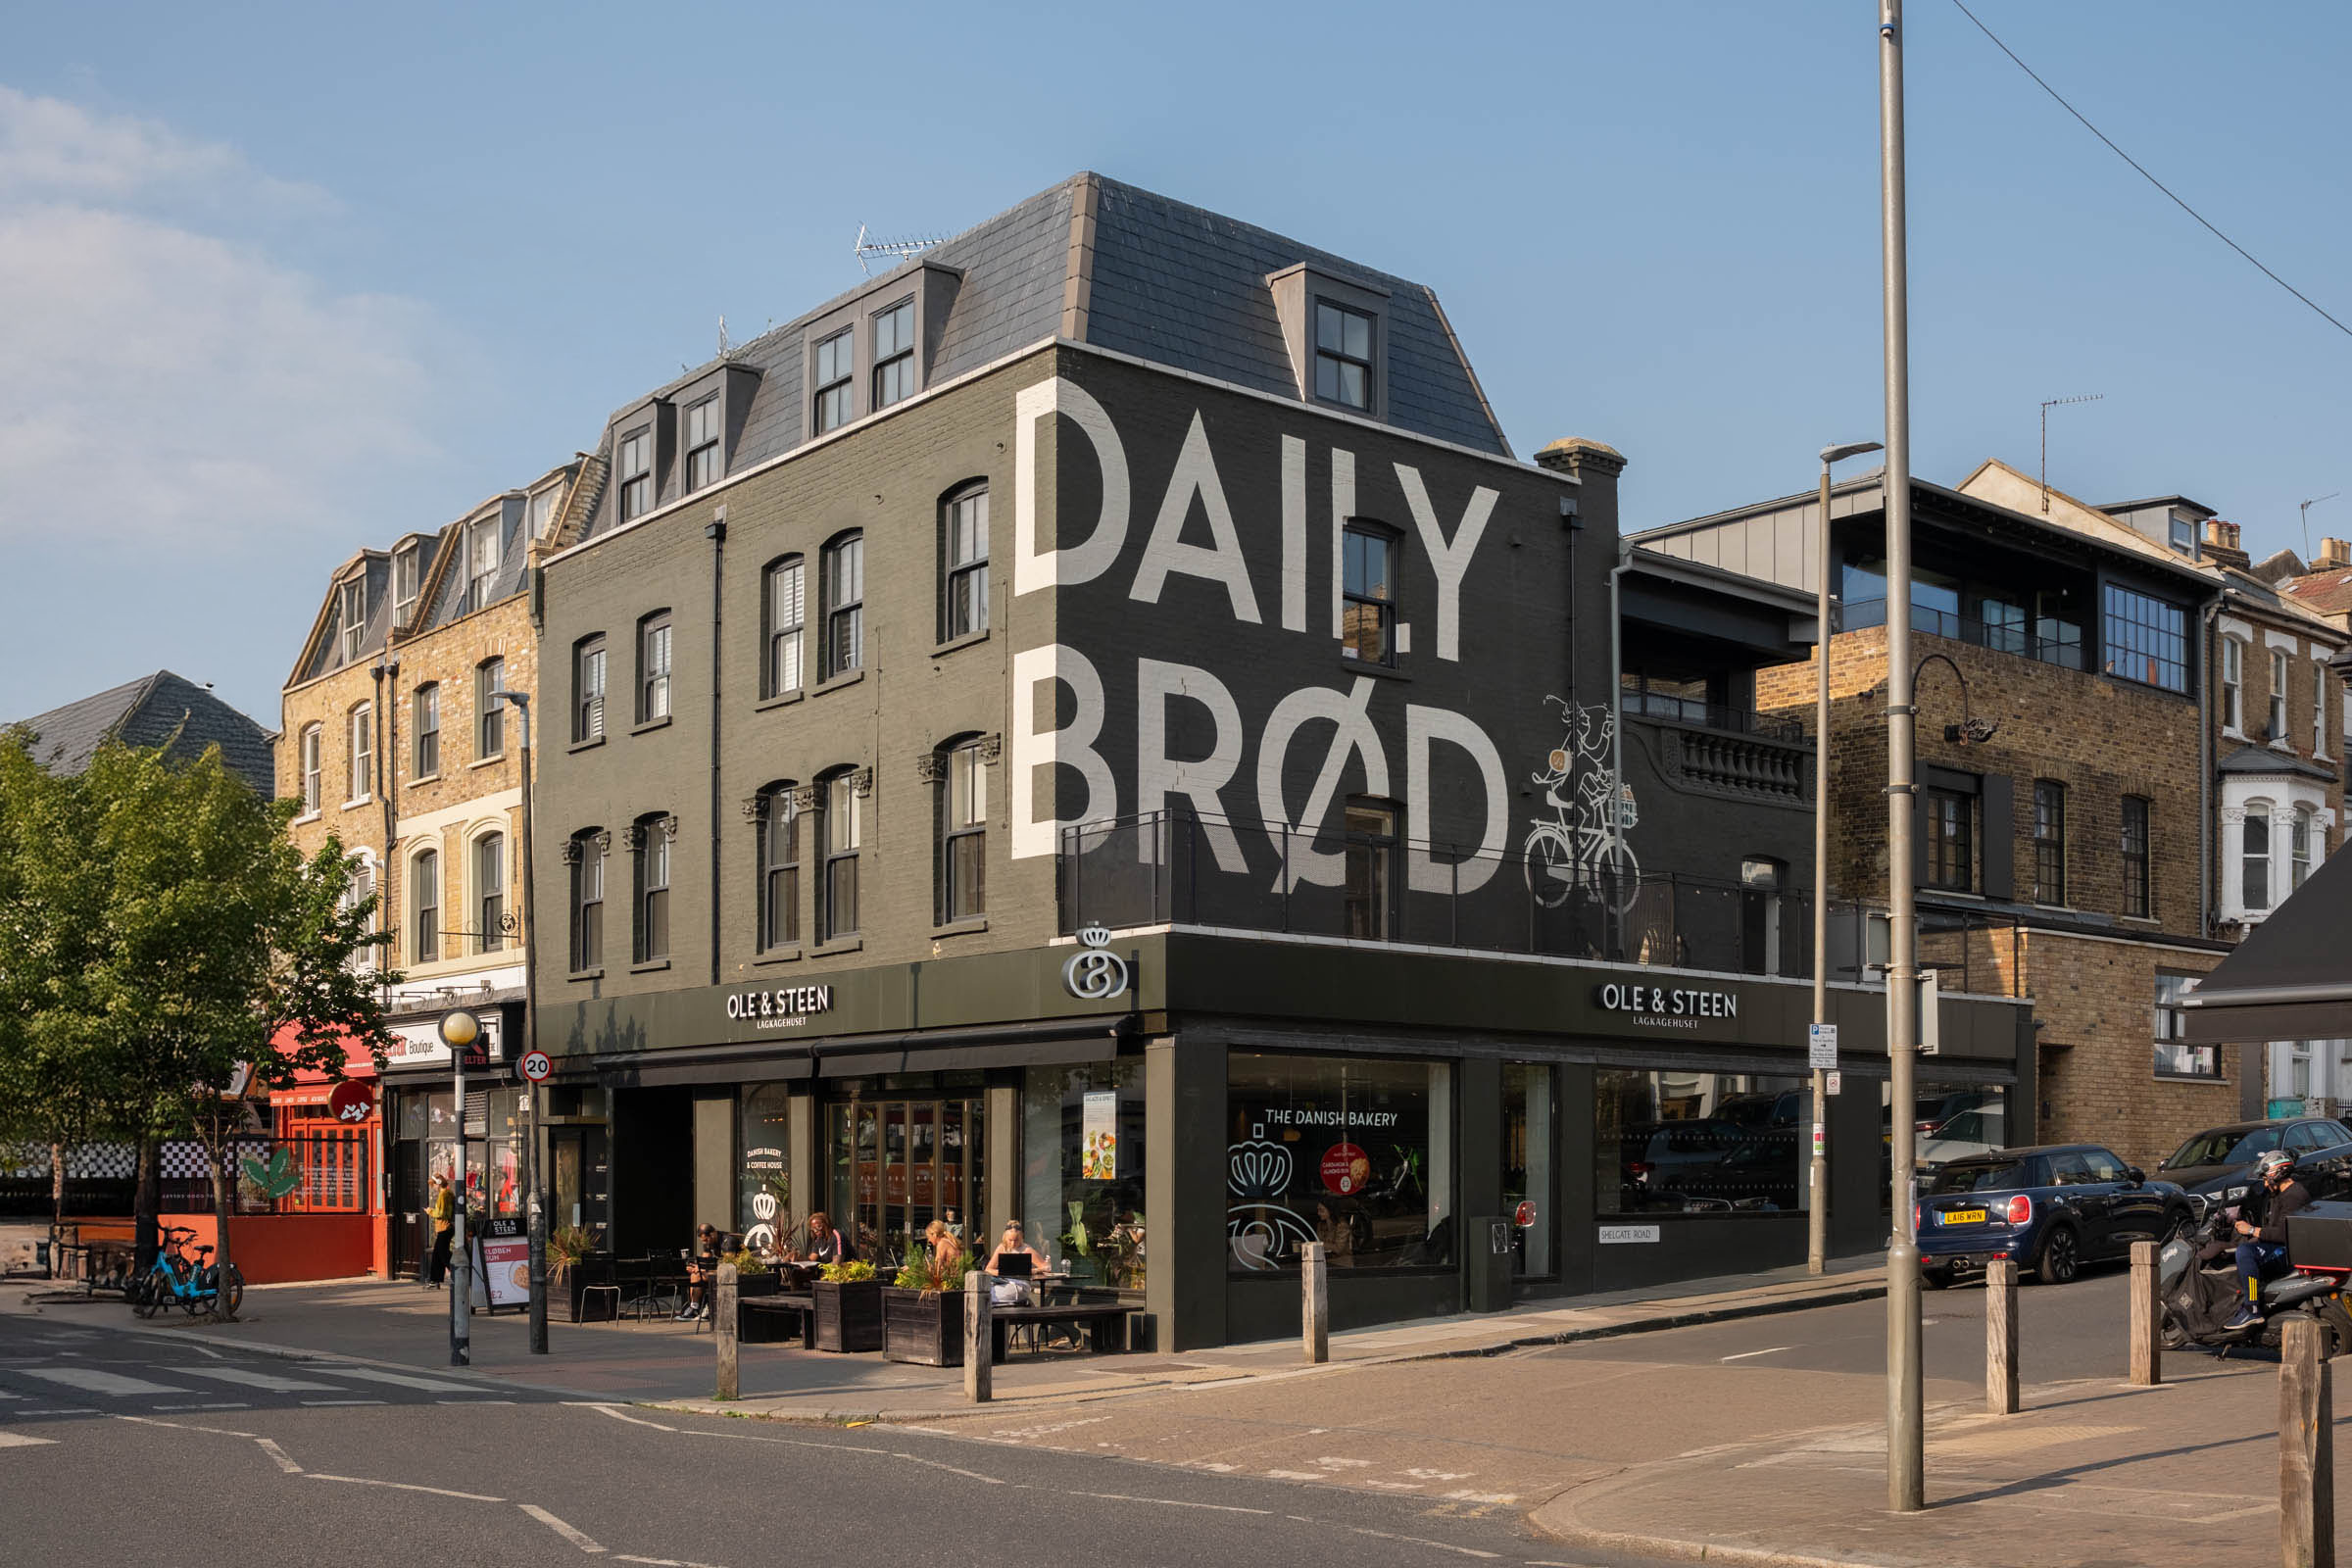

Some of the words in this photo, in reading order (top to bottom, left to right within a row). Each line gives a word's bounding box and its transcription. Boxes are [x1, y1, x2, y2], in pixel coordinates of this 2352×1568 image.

[1014, 376, 1499, 662] DAILY
[1012, 643, 1509, 896] BRØD
[727, 993, 756, 1018] OLE
[760, 991, 772, 1015] &
[776, 985, 828, 1014] STEEN
[1603, 983, 1644, 1011] OLE
[1651, 987, 1666, 1013] &
[1673, 989, 1737, 1018] STEEN
[757, 1016, 807, 1029] LAGKAGEHUSET
[1633, 1015, 1698, 1029] LAGKAGEHUSET
[409, 1039, 434, 1058] Boutique
[464, 1054, 487, 1065] ELTER
[526, 1059, 548, 1073] 20
[1265, 1108, 1292, 1124] THE
[1296, 1110, 1345, 1126] DANISH
[1348, 1111, 1398, 1127] BAKERY
[747, 1148, 763, 1157] DANISH
[764, 1148, 782, 1157] BAKERY
[1946, 1212, 1965, 1223] LA16
[1966, 1211, 1983, 1221] WRN
[1601, 1230, 1631, 1240] SHELGATE
[1633, 1229, 1651, 1240] ROAD
